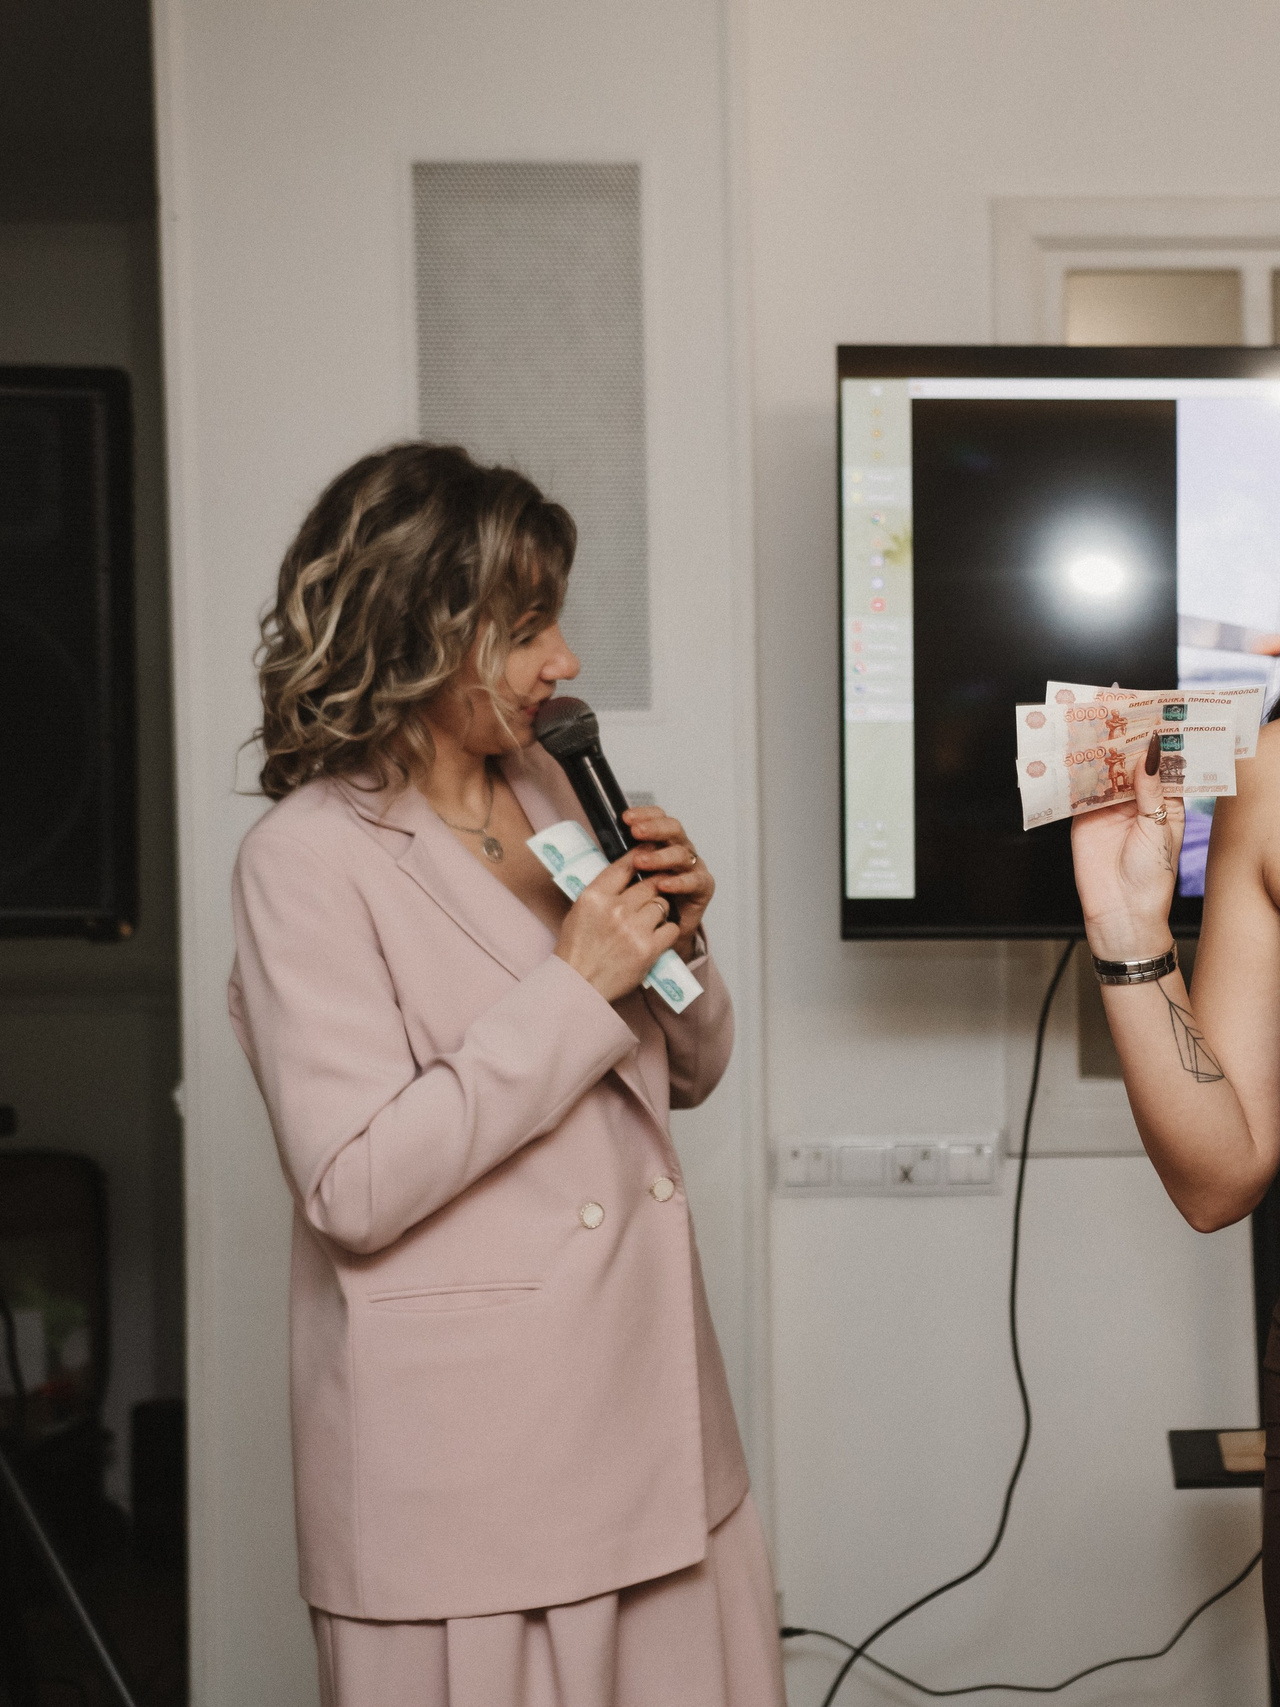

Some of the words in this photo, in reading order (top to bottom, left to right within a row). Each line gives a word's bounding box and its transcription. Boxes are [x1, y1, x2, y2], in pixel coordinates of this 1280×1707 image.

[1128, 699, 1155, 709] БИЛЕТ
[1187, 697, 1232, 705] ПРИКОЛОВ
[1064, 706, 1109, 722] 5000
[1125, 731, 1149, 744] БИЛЕТ
[1064, 746, 1107, 767] 5000
